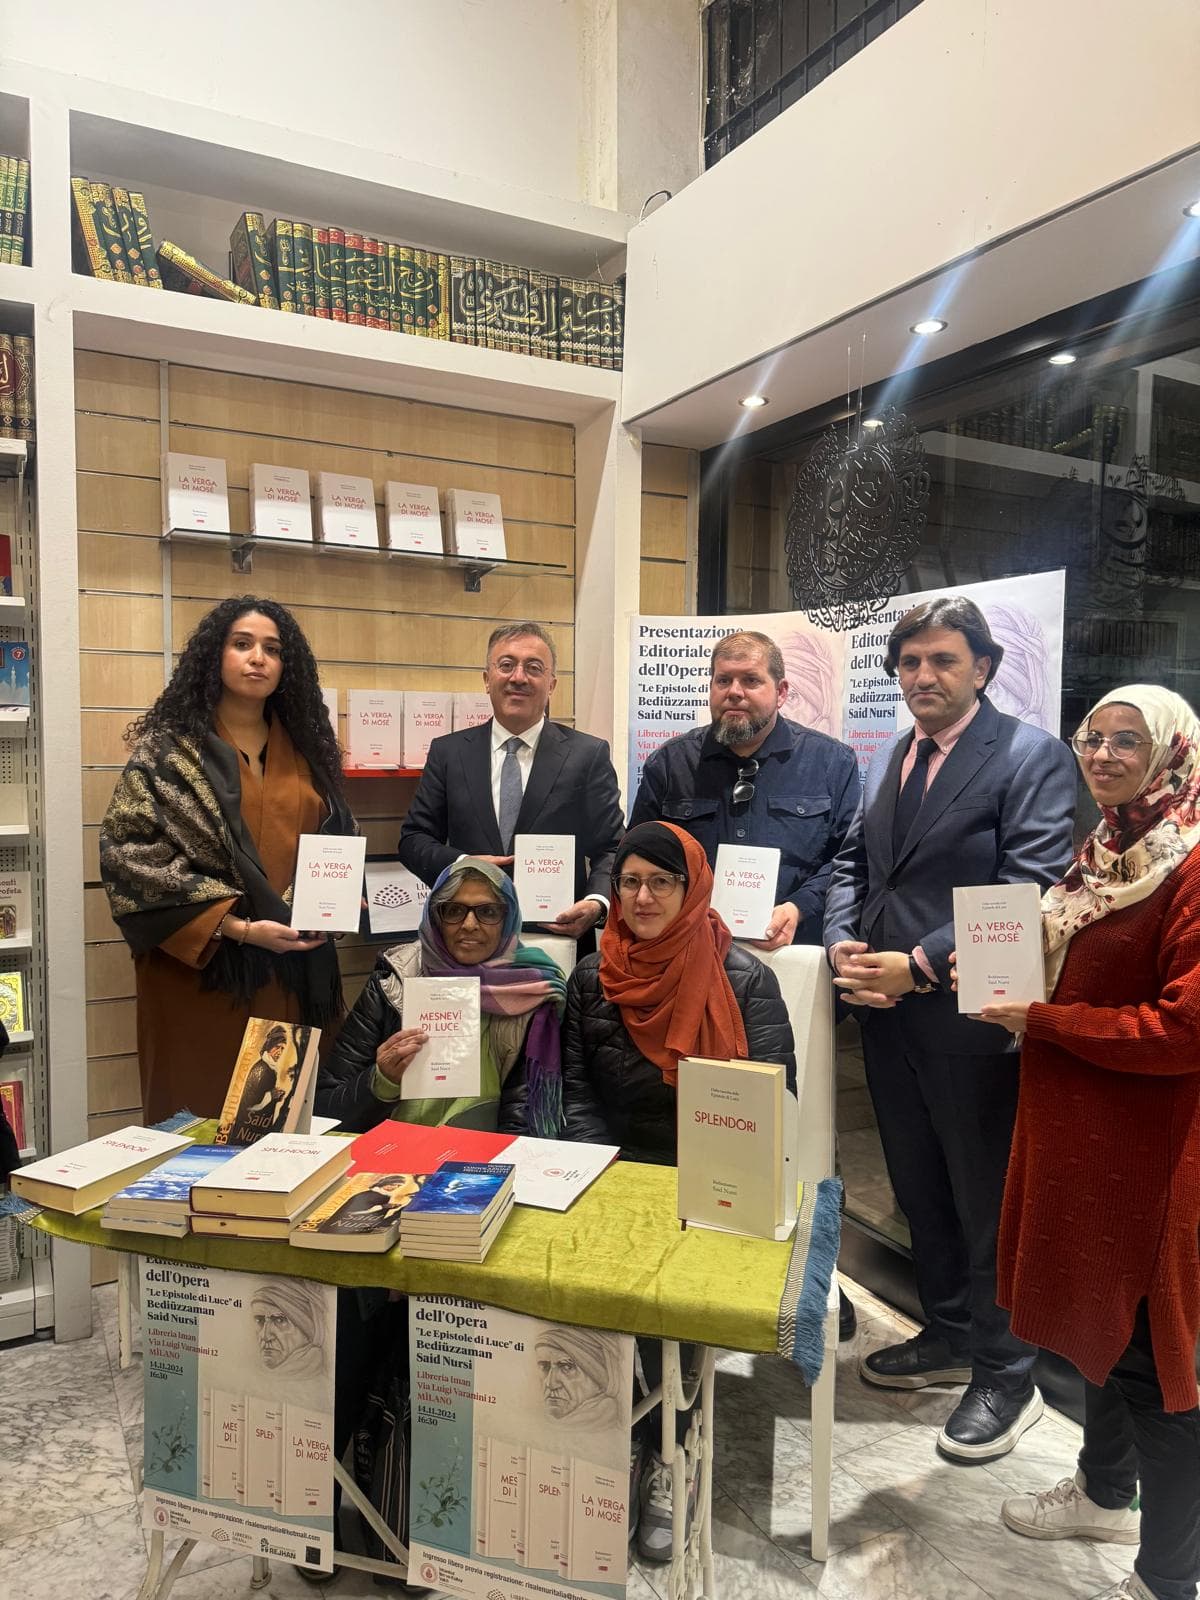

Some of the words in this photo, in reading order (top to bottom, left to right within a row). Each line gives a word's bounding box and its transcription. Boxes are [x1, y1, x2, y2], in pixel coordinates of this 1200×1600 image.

[192, 476, 217, 487] VERGA
[276, 488, 301, 496] VERGA
[344, 496, 366, 504] VERGA
[476, 510, 494, 518] VERGA
[639, 645, 712, 658] Editoriale
[638, 663, 711, 679] dell'Opera
[656, 684, 696, 695] Epistole
[698, 684, 708, 693] di
[638, 696, 709, 708] Bediüzzama
[638, 710, 662, 720] Said
[664, 710, 696, 720] Nursi
[848, 707, 869, 719] Said
[870, 706, 896, 718] Nursi
[638, 730, 670, 738] Libreria
[324, 862, 352, 871] VERGA
[312, 870, 320, 878] DI
[724, 870, 736, 878] LA
[738, 871, 766, 880] VERGA
[968, 922, 982, 932] LA
[986, 922, 1024, 932] VERGA
[972, 934, 983, 944] DI
[422, 1023, 432, 1032] DI
[435, 1022, 460, 1032] LUCE
[244, 1111, 272, 1128] Said
[694, 1110, 756, 1133] SPLENDORI
[236, 1127, 264, 1142] Nur
[146, 1269, 210, 1288] dell'Opera
[162, 1290, 197, 1302] Epistole
[198, 1294, 207, 1302] di
[234, 1300, 242, 1308] di
[148, 1300, 214, 1316] Bediüzzaman
[148, 1312, 168, 1322] Said
[171, 1313, 198, 1326] Nursi
[416, 1308, 488, 1329] dell'Opera
[148, 1328, 177, 1338] Libreria
[178, 1332, 196, 1342] Iman
[434, 1330, 472, 1343] Epistole
[474, 1334, 484, 1345] di
[514, 1342, 524, 1352] di
[149, 1338, 160, 1347] Via
[162, 1340, 180, 1350] Luigi
[181, 1343, 210, 1356] Varanini
[211, 1348, 218, 1356] 12
[416, 1340, 493, 1360] Bediüzzaman
[150, 1360, 184, 1373] 14.11.2024
[416, 1352, 440, 1364] Said
[442, 1356, 472, 1370] Nursi
[150, 1371, 168, 1380] 16:30
[416, 1371, 449, 1382] Libreria
[450, 1375, 471, 1387] Iman
[417, 1382, 430, 1391] Via
[432, 1384, 452, 1395] Luigi
[454, 1388, 486, 1402] Varanini
[488, 1396, 496, 1404] 12
[418, 1406, 456, 1420] 14.11.2024
[417, 1416, 438, 1426] 16:30
[224, 1432, 232, 1442] DI
[292, 1436, 304, 1446] LA
[306, 1439, 330, 1452] VERGA
[296, 1448, 304, 1458] DI
[502, 1486, 512, 1497] DI
[582, 1494, 594, 1504] LA
[598, 1496, 626, 1512] VERGA
[585, 1506, 594, 1518] DI
[422, 1551, 446, 1564] Ingresso
[448, 1558, 464, 1570] libero
[464, 1563, 482, 1576] previa
